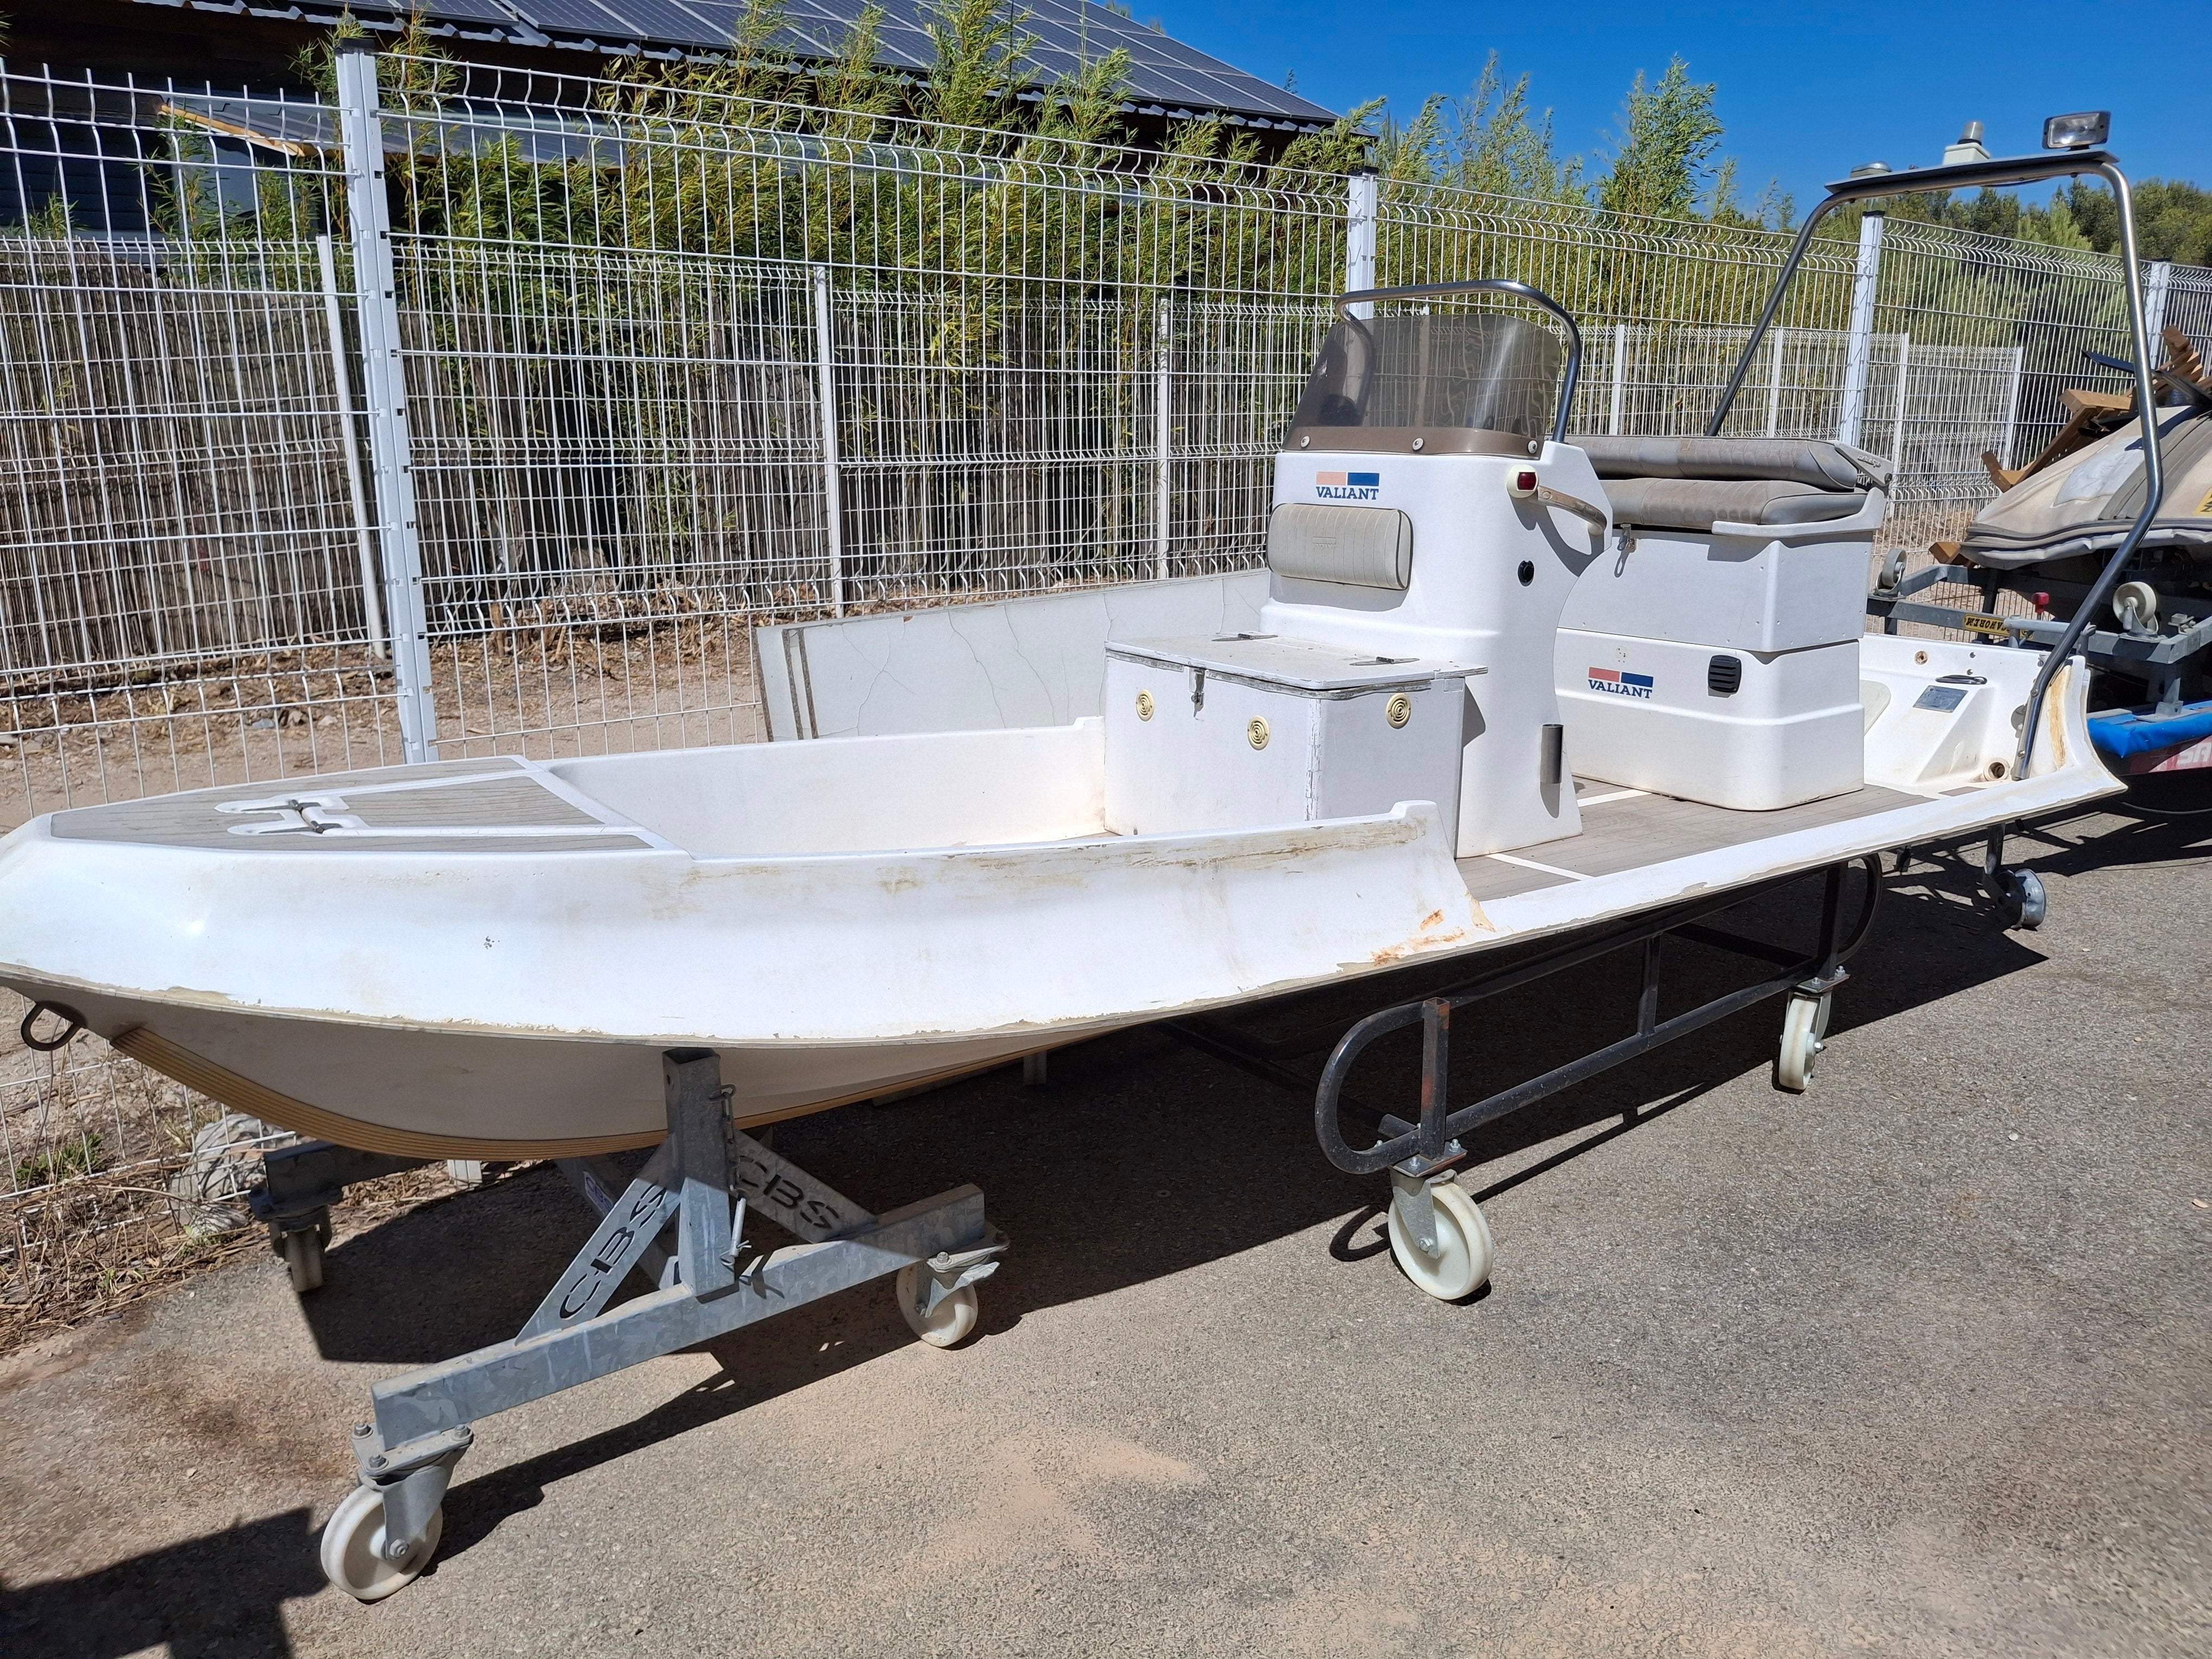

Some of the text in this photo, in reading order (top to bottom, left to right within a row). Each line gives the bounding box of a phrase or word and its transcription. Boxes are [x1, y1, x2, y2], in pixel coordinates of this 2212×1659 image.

[1316, 486, 1379, 500] VALIANT
[1588, 679, 1652, 699] VALIANT
[560, 1179, 667, 1319] CBS
